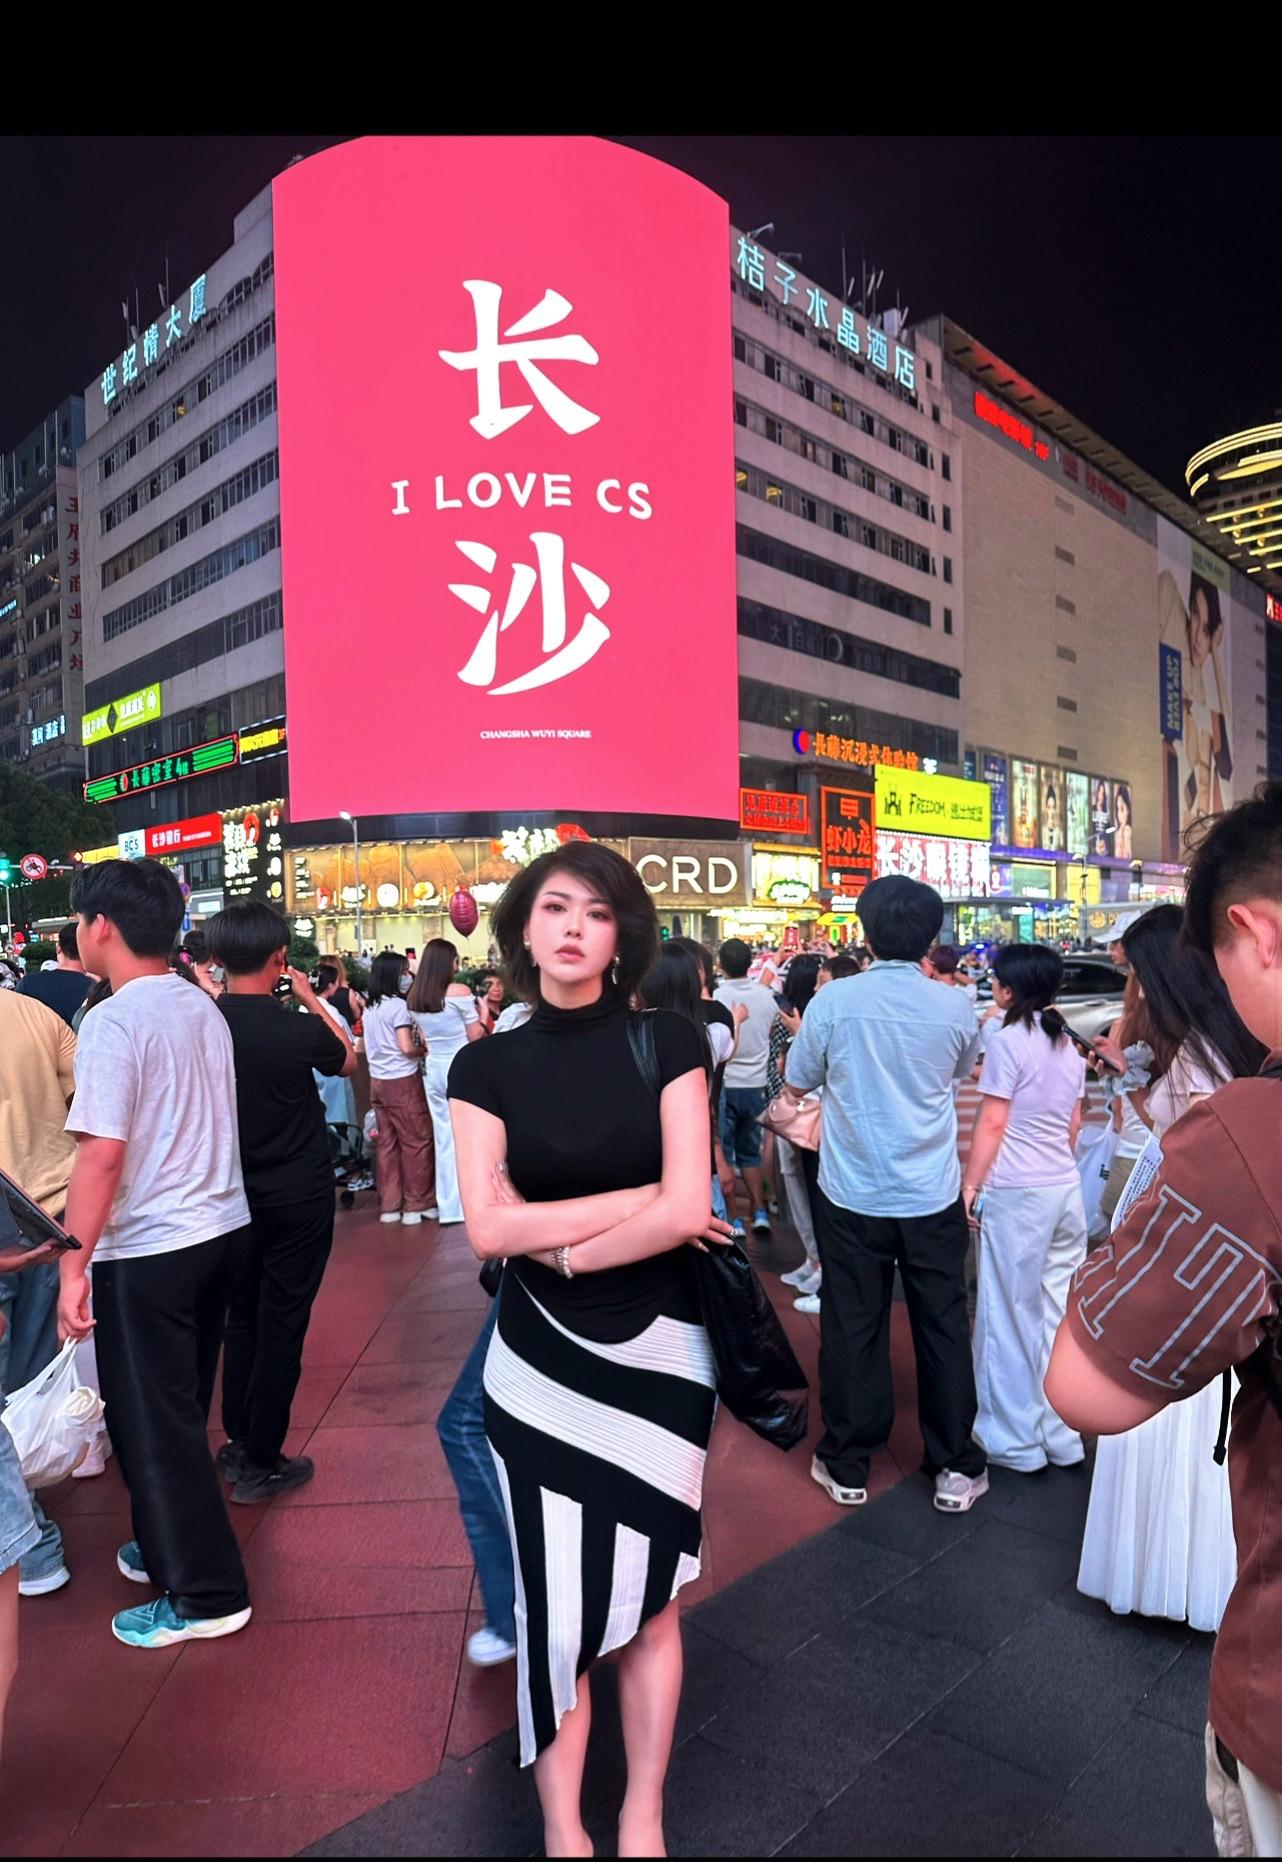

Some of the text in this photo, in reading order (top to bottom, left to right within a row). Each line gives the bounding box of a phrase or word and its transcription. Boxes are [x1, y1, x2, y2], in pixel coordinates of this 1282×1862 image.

[736, 236, 915, 391] 桔子水晶酒店
[438, 279, 601, 440] 长
[391, 472, 653, 520] I LOVE CS
[447, 531, 611, 696] 沙
[480, 729, 592, 739] CHANGSHA WUYI SQUARE
[909, 793, 946, 818] FREEDOM
[124, 838, 139, 852] BCS
[152, 828, 182, 849] 长沙银行
[635, 854, 738, 894] CRD
